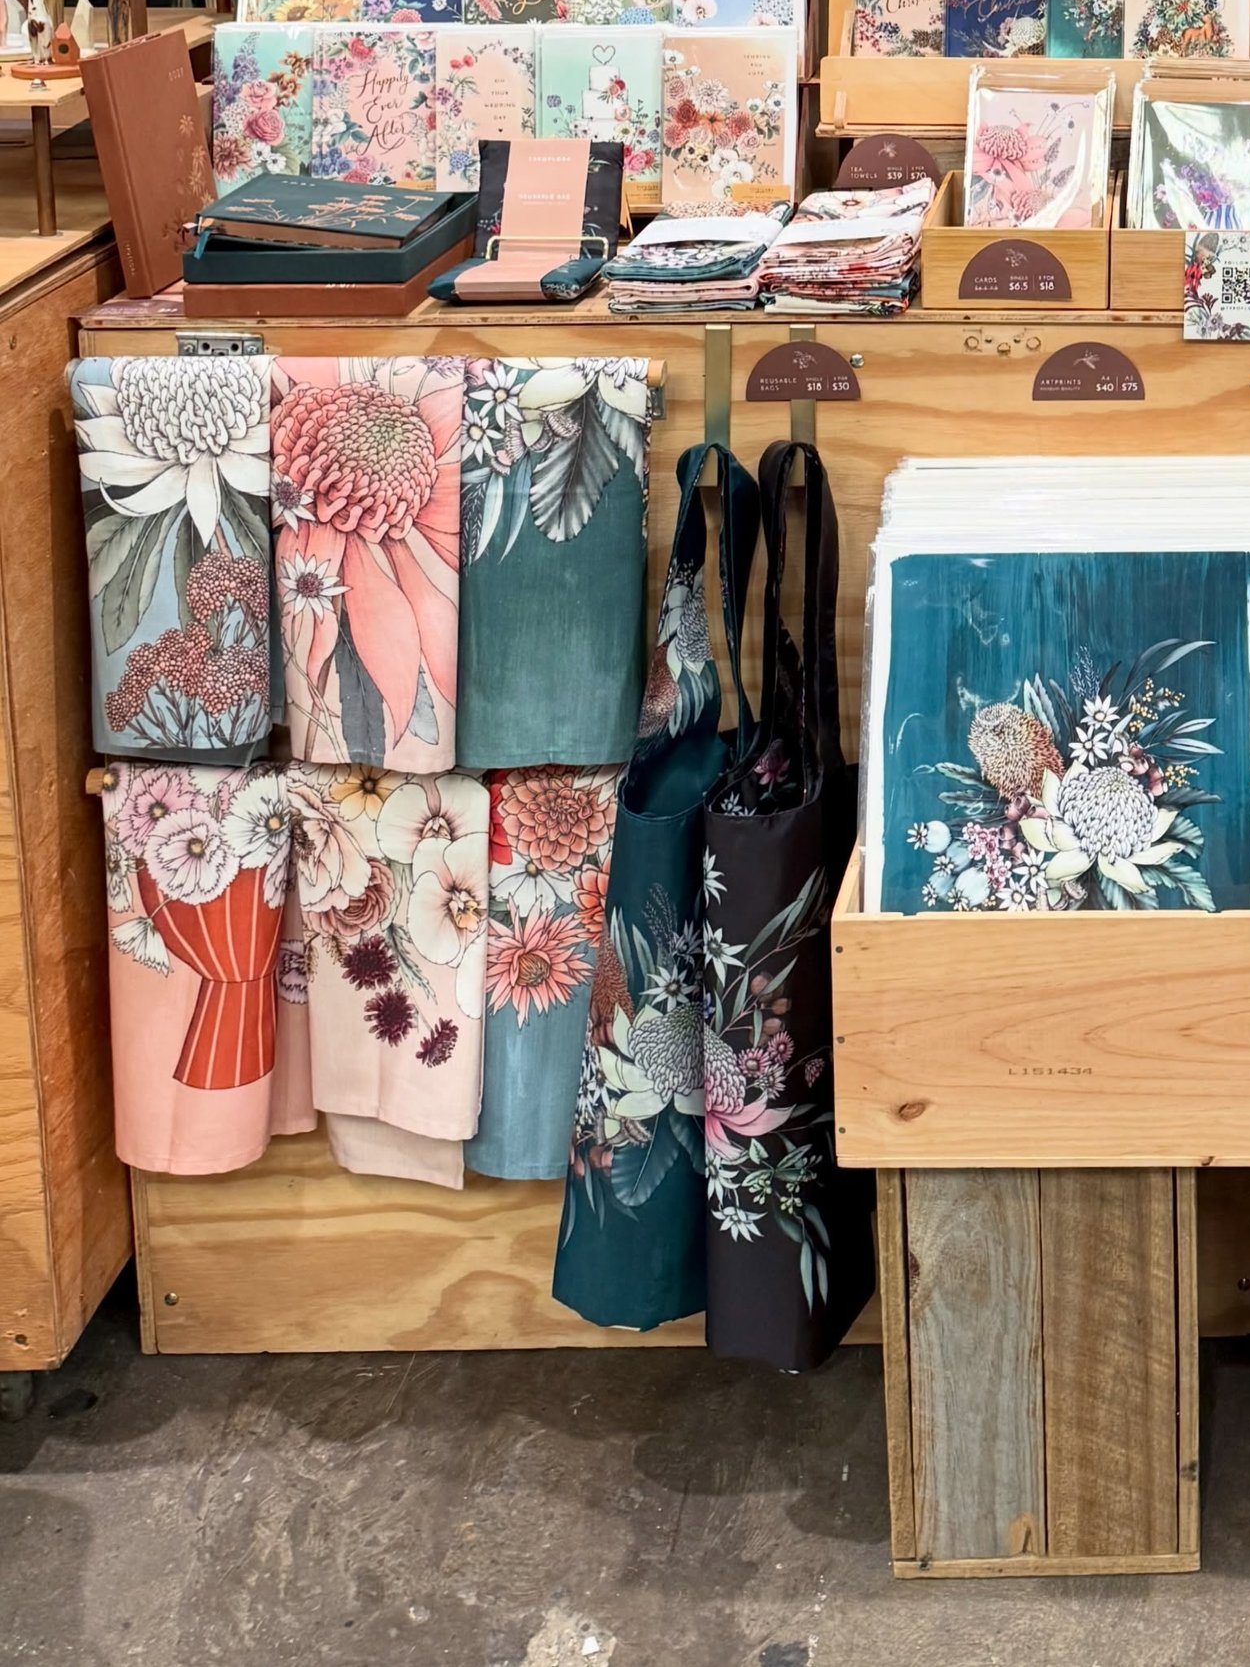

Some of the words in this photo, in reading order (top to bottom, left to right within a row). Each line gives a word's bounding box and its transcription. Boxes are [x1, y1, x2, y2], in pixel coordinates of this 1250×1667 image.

[363, 95, 403, 124] Ever
[354, 113, 419, 155] After
[887, 172, 903, 180] $39
[910, 172, 927, 180] $70
[1009, 282, 1028, 291] $6.5
[1040, 282, 1055, 291] $18
[807, 382, 822, 391] $18
[832, 382, 850, 391] $30
[1095, 383, 1114, 392] $40
[1121, 382, 1138, 391] $75
